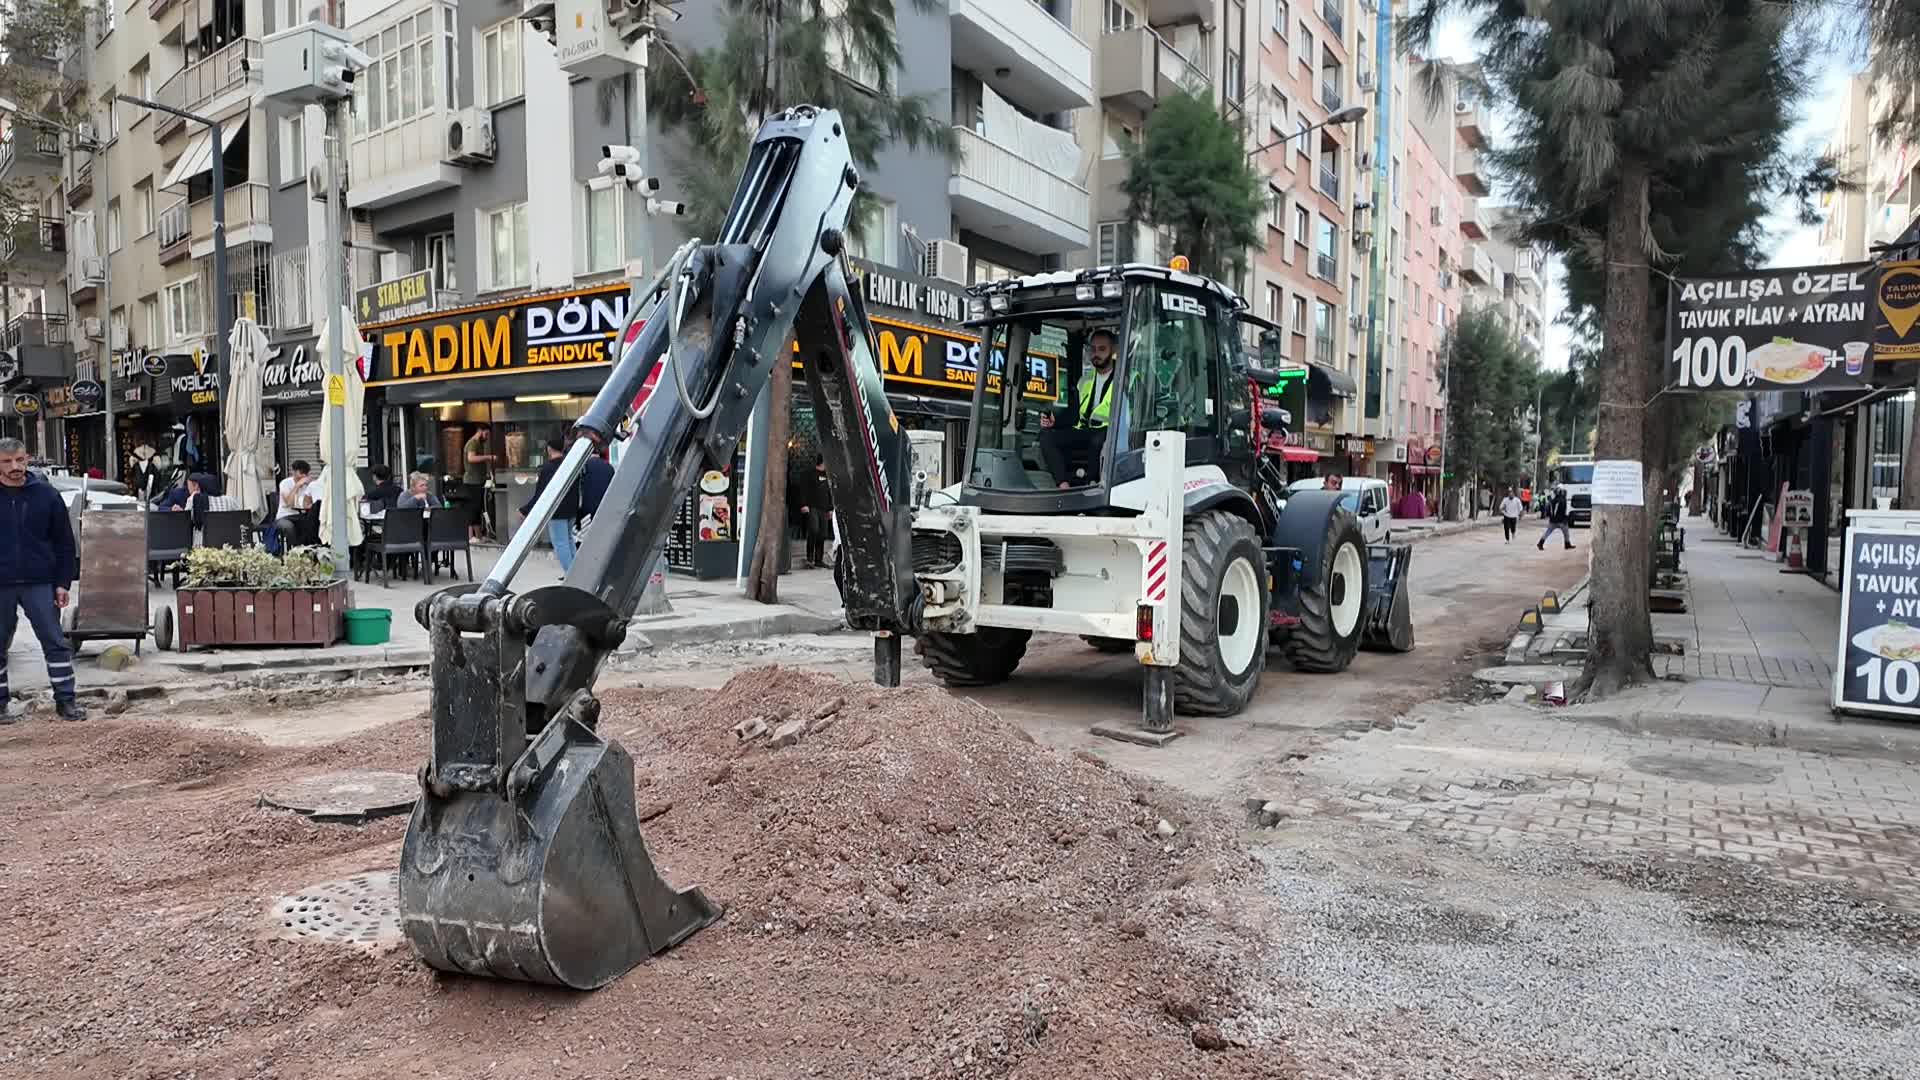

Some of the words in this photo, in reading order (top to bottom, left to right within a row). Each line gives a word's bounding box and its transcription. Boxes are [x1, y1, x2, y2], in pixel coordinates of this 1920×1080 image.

[377, 281, 400, 308] STAR
[869, 271, 917, 309] EMLAK
[1680, 278, 1783, 304] AÇILIŞA
[1792, 272, 1865, 294] ÖZEL
[527, 295, 632, 338] DÖN
[1679, 308, 1731, 329] TAVUK
[1734, 303, 1784, 327] PİLAV
[1802, 302, 1865, 323] AYRAN
[383, 314, 511, 378] TADIM
[171, 369, 220, 393] MOBİLPA
[191, 390, 217, 405] GSM
[1856, 574, 1919, 595] TAVUK
[1890, 598, 1920, 617] AY
